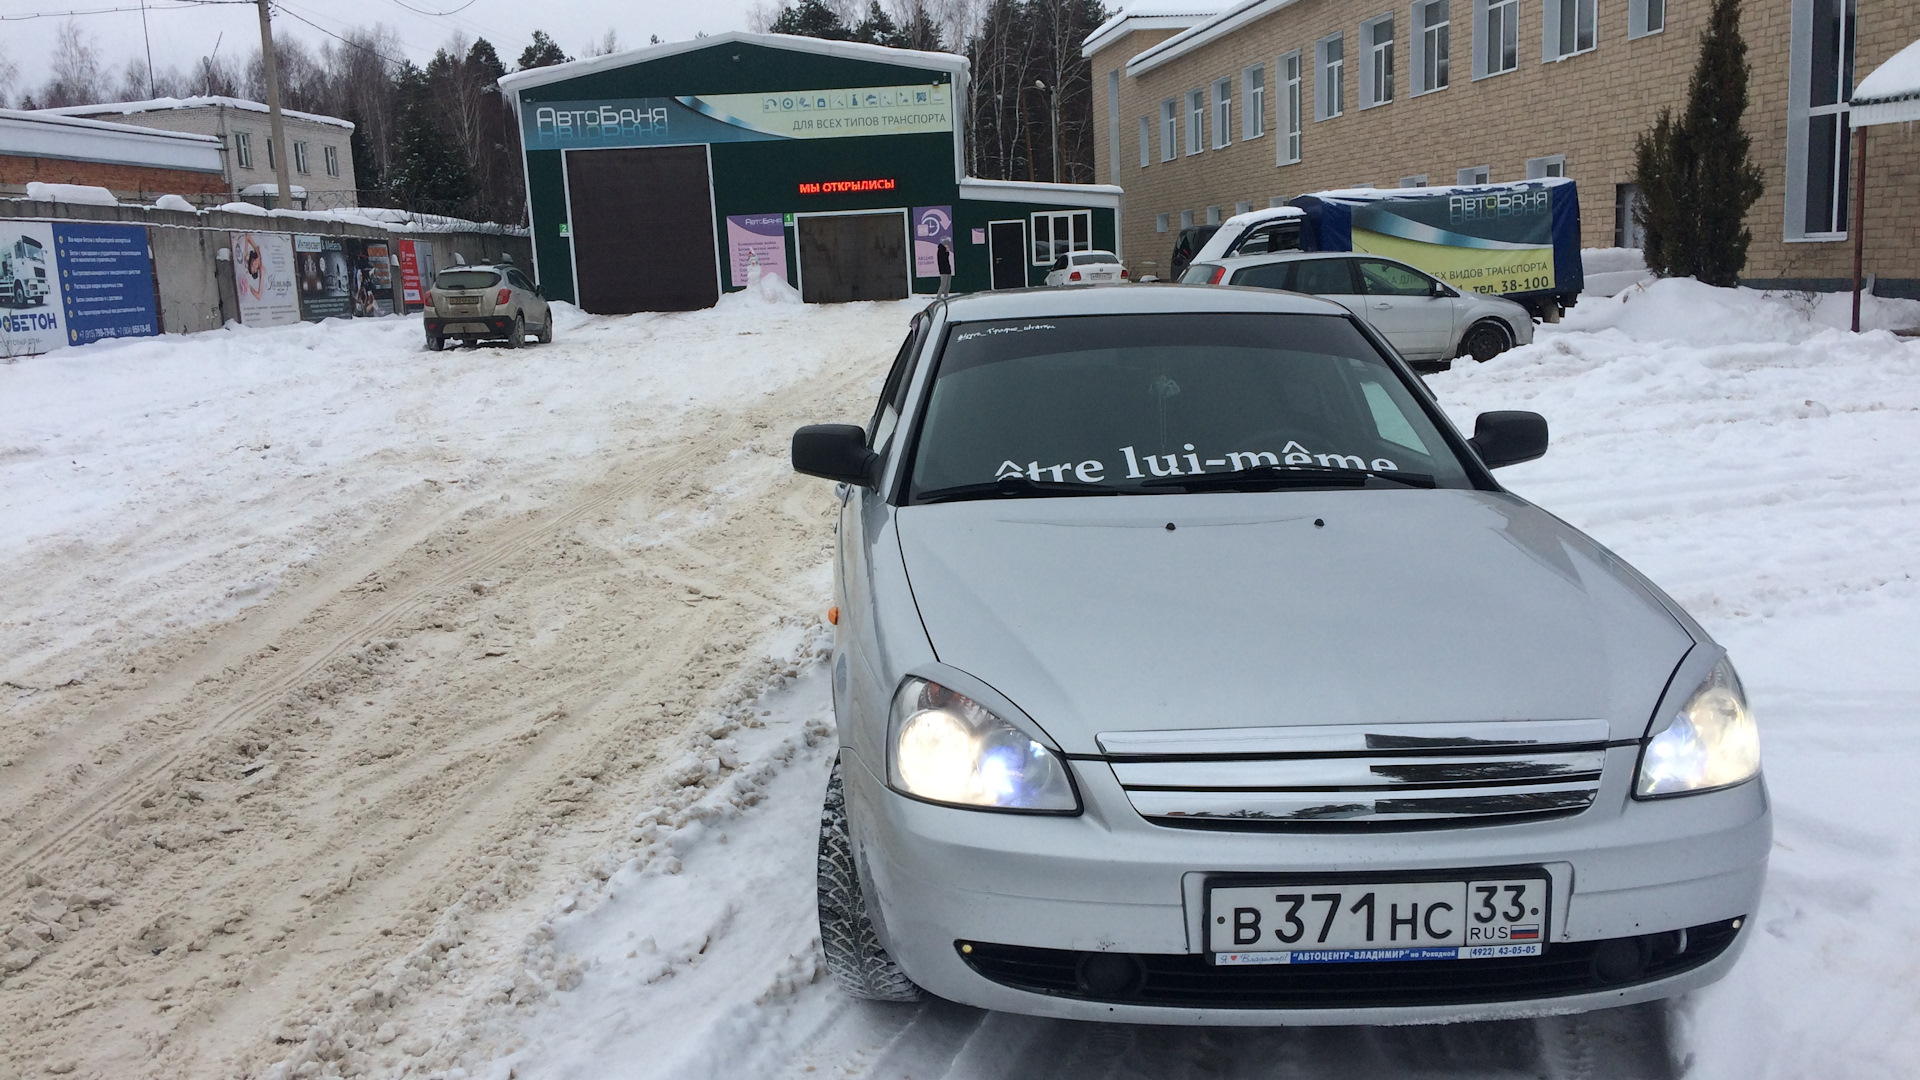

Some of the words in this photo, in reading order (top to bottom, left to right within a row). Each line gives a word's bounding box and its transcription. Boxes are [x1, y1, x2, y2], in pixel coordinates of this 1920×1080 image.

[793, 120, 814, 131] ДЛЯ
[816, 118, 842, 129] ВСЕХ
[844, 116, 879, 128] ТИПОВ
[881, 113, 946, 126] ТРАНСПОРТА
[799, 183, 820, 194] МЫ
[786, 214, 791, 222] 1
[561, 224, 568, 233] 2
[1450, 269, 1483, 280] ВИДОВ
[1486, 262, 1548, 276] ТРАНСПОРТА
[1502, 276, 1549, 292] 38-100
[0, 312, 57, 332] ОБЕТОН
[1473, 885, 1526, 923] 33
[1470, 926, 1508, 940] RUS
[1422, 950, 1456, 958] Рокадной
[1469, 948, 1494, 957] (4922)
[1498, 946, 1536, 955] 43-05-05
[1221, 956, 1228, 964] Я
